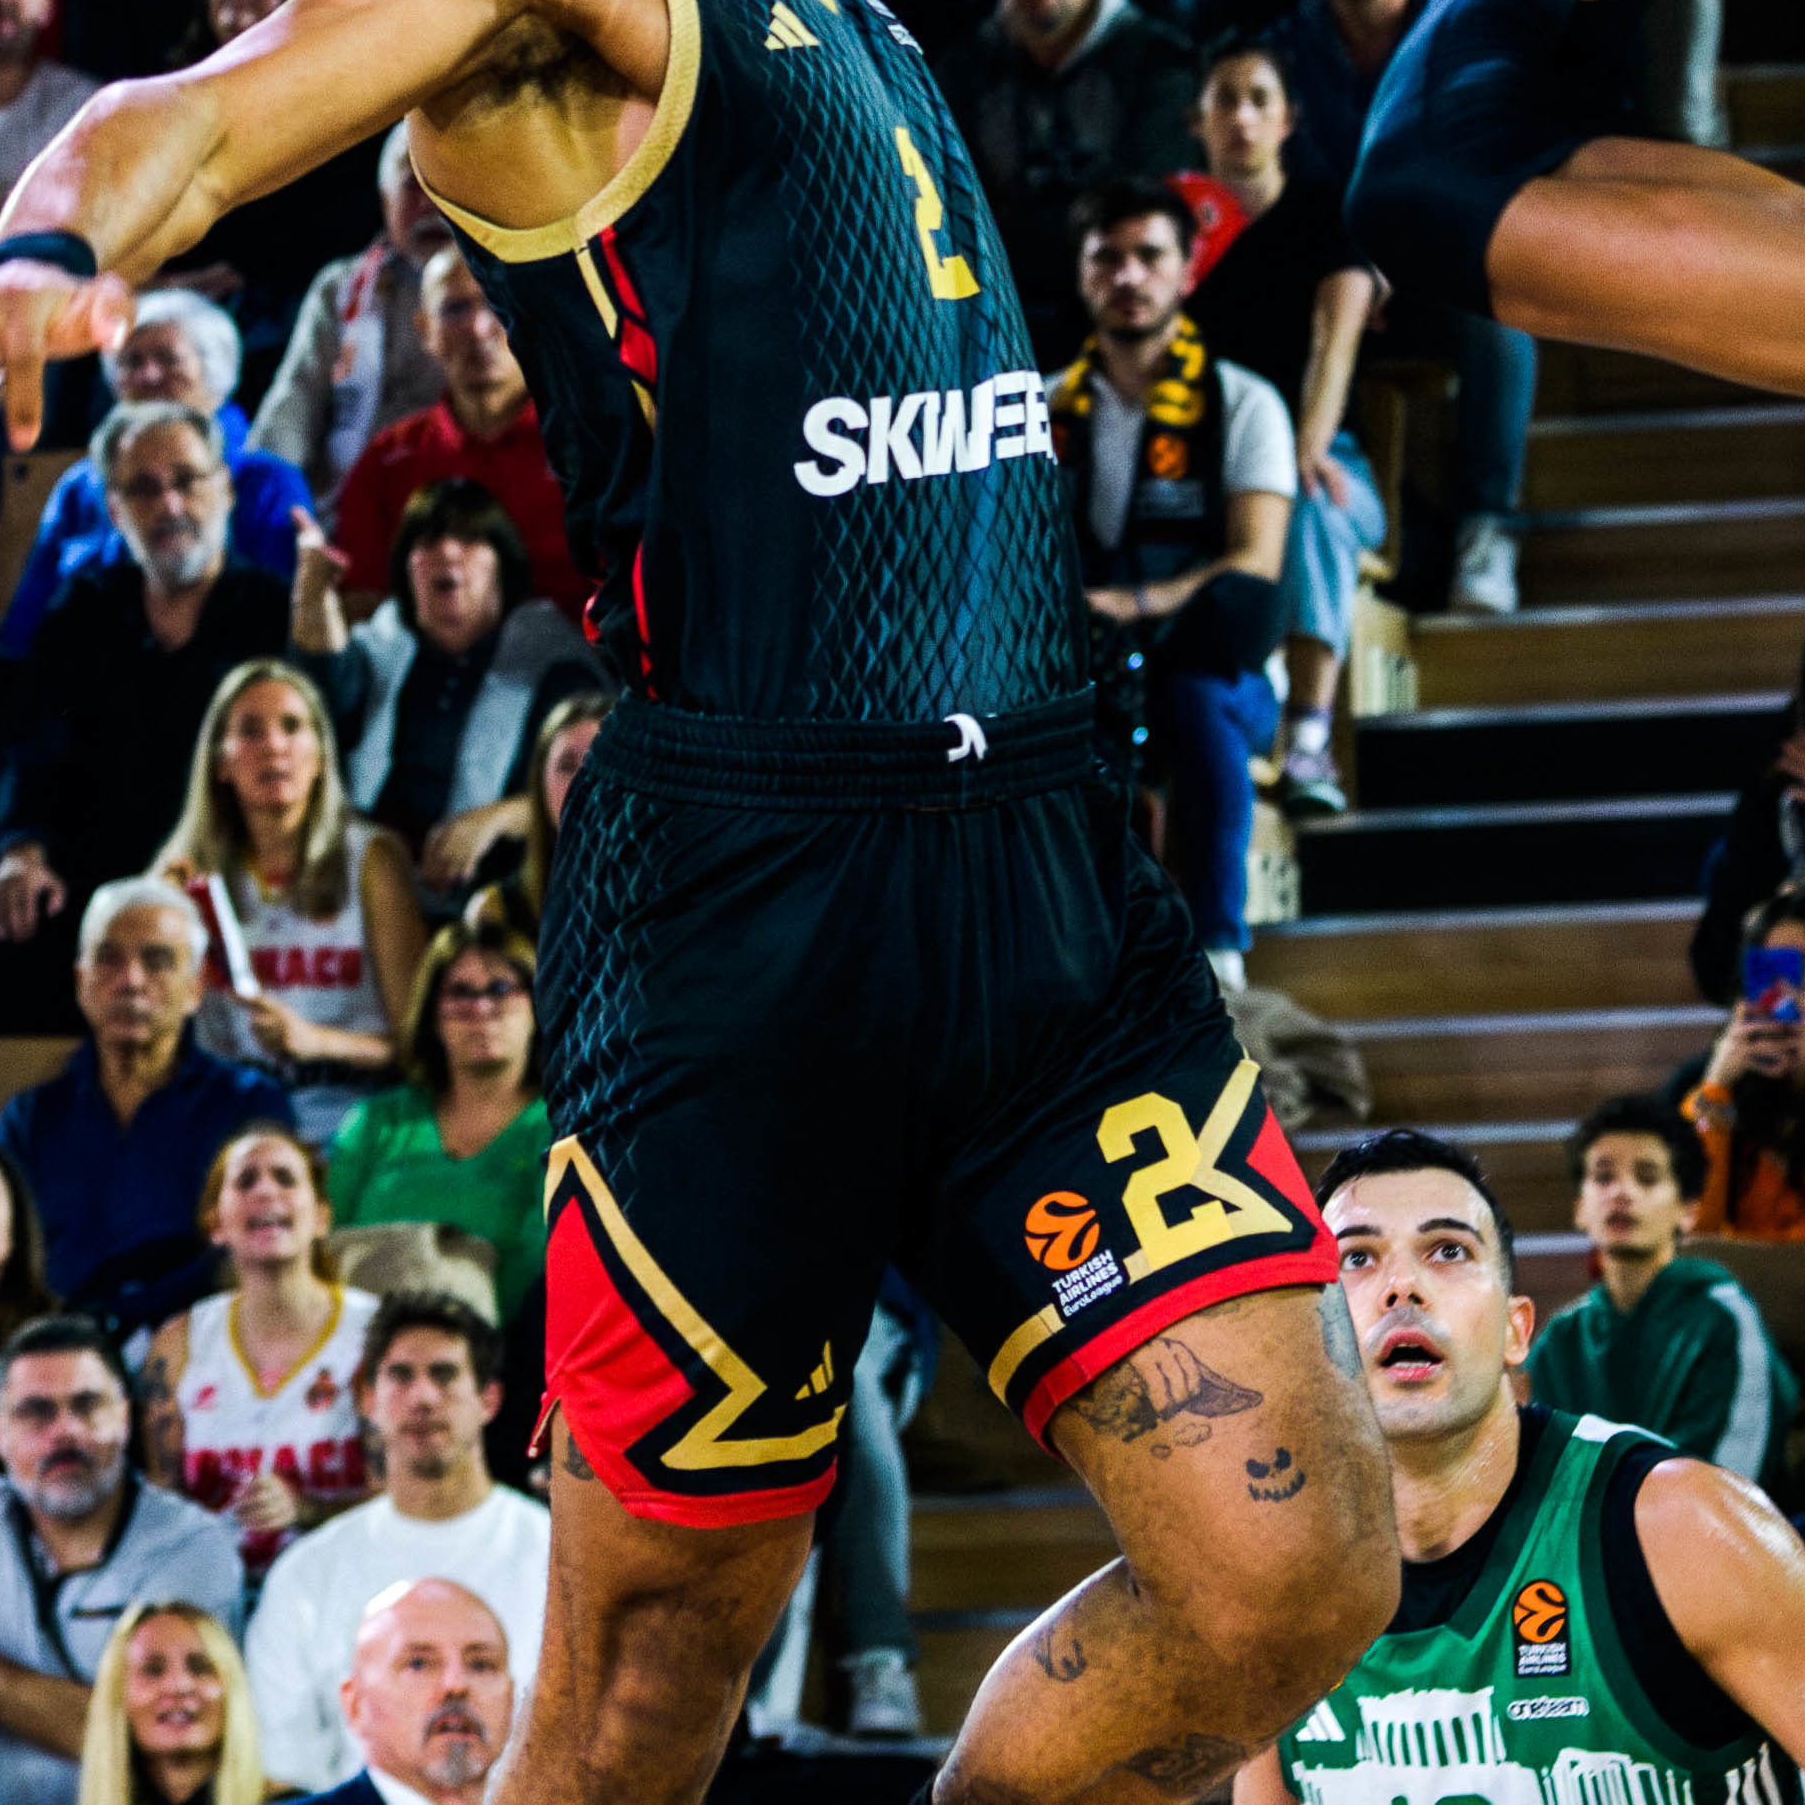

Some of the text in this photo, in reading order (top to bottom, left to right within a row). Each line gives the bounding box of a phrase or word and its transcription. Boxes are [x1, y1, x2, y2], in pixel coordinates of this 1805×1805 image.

[895, 127, 981, 300] 2
[794, 369, 1059, 498] SKWEE
[1096, 1091, 1236, 1268] 2
[1052, 1249, 1114, 1294] TURKISH
[1059, 1262, 1119, 1307] AIRLINES
